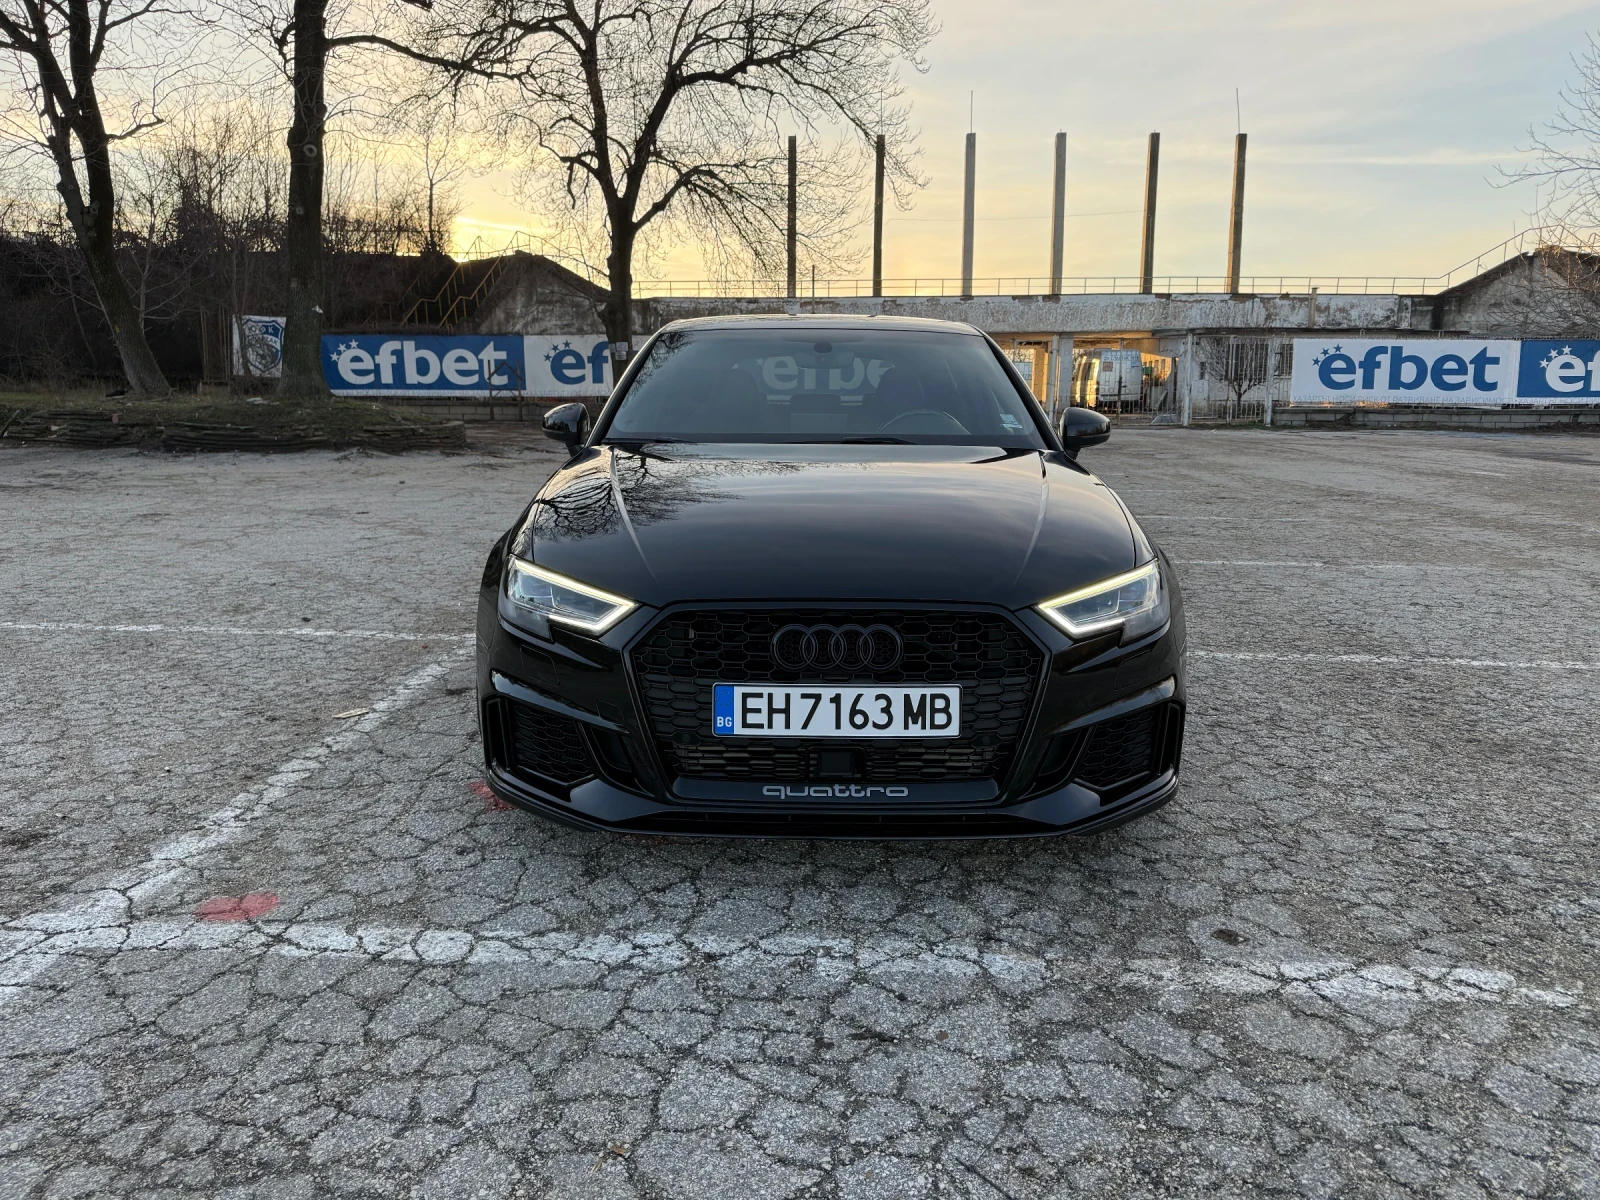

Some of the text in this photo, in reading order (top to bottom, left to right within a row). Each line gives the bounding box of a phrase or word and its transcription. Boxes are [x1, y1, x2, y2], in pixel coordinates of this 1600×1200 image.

[337, 340, 509, 385] efbet
[1318, 345, 1501, 392] efbet
[716, 716, 732, 728] BG
[741, 692, 953, 731] EH 7163 MB
[762, 783, 909, 800] quattro
